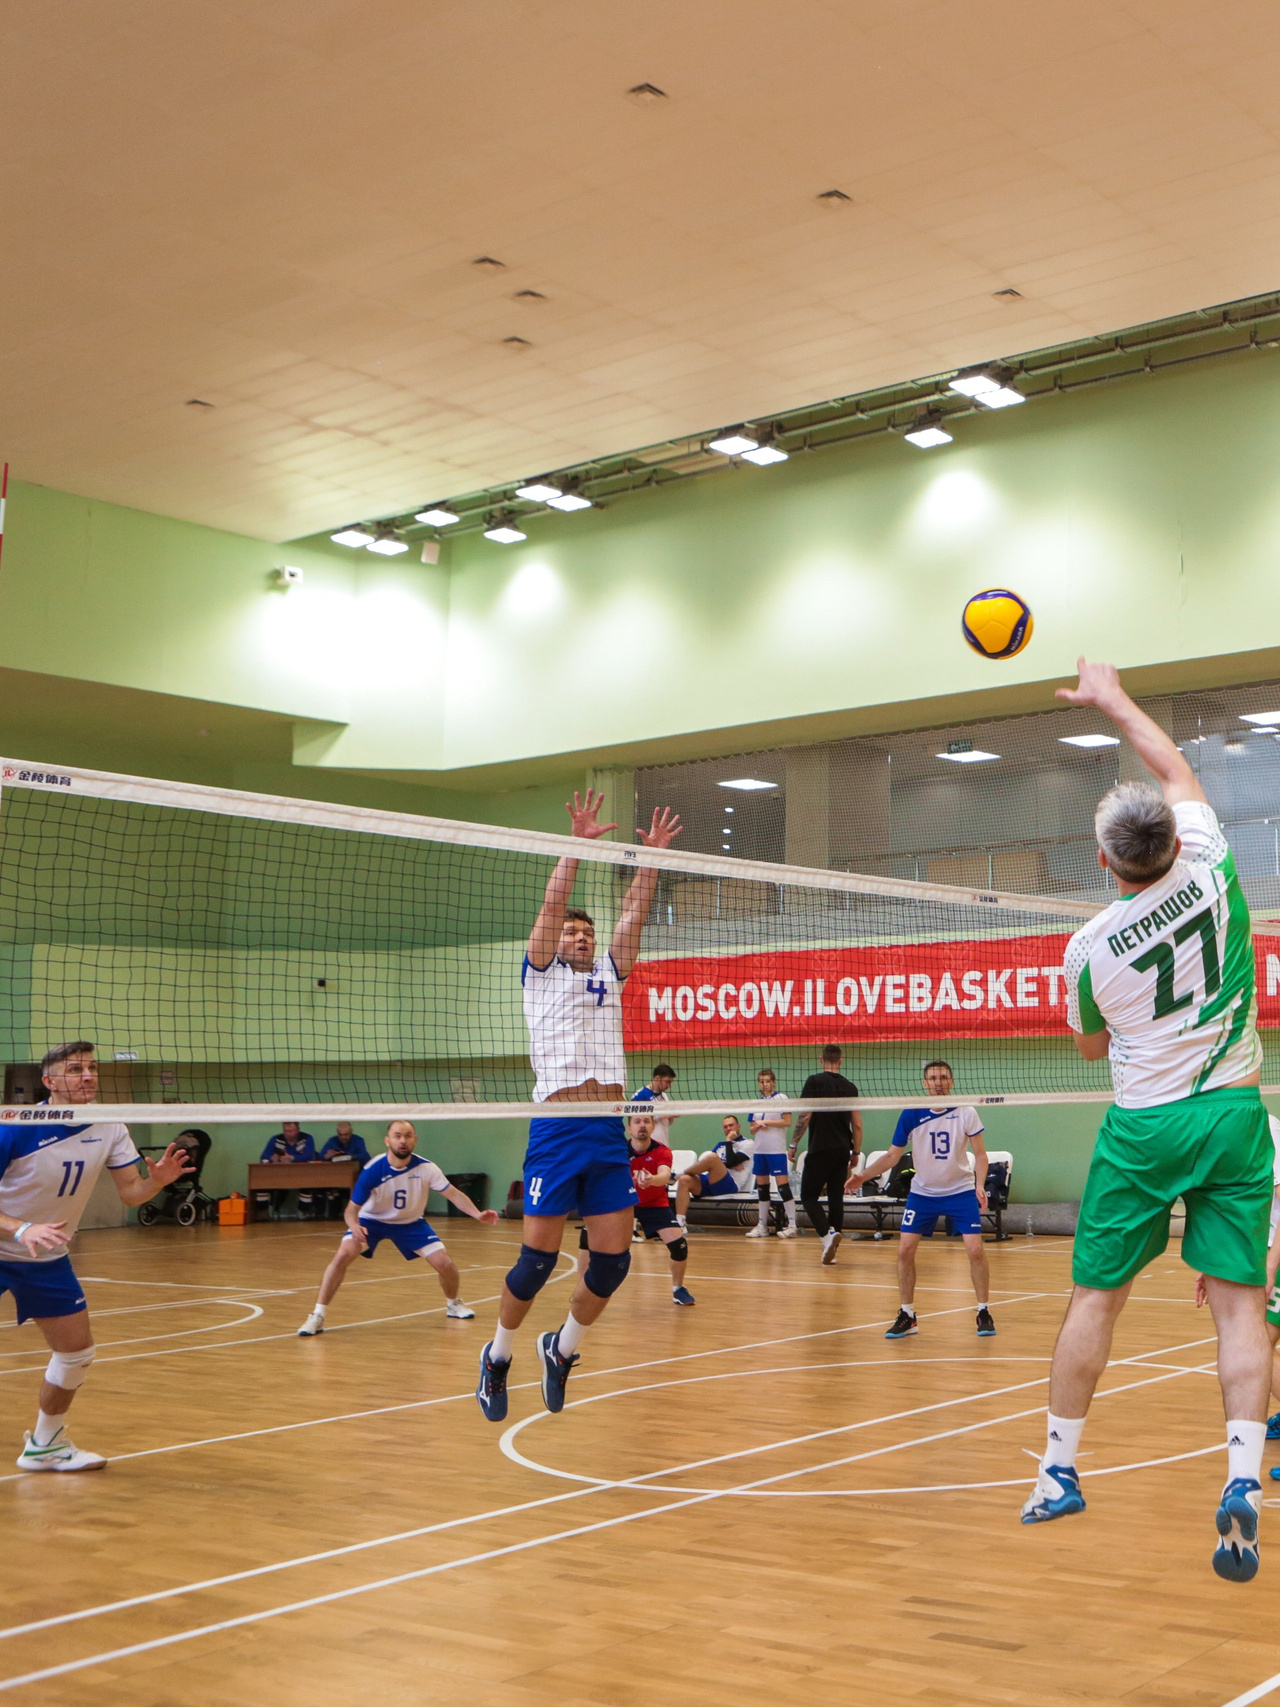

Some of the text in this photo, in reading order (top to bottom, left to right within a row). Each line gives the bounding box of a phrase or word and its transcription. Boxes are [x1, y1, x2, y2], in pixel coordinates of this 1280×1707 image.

[1106, 879, 1204, 958] ПЕТРАШОВ
[1128, 906, 1221, 1022] 27
[586, 978, 608, 1007] 4
[929, 1131, 951, 1155] 13
[57, 1160, 85, 1197] 11
[529, 1177, 543, 1206] 4
[393, 1189, 408, 1210] 6
[901, 1208, 916, 1226] 13
